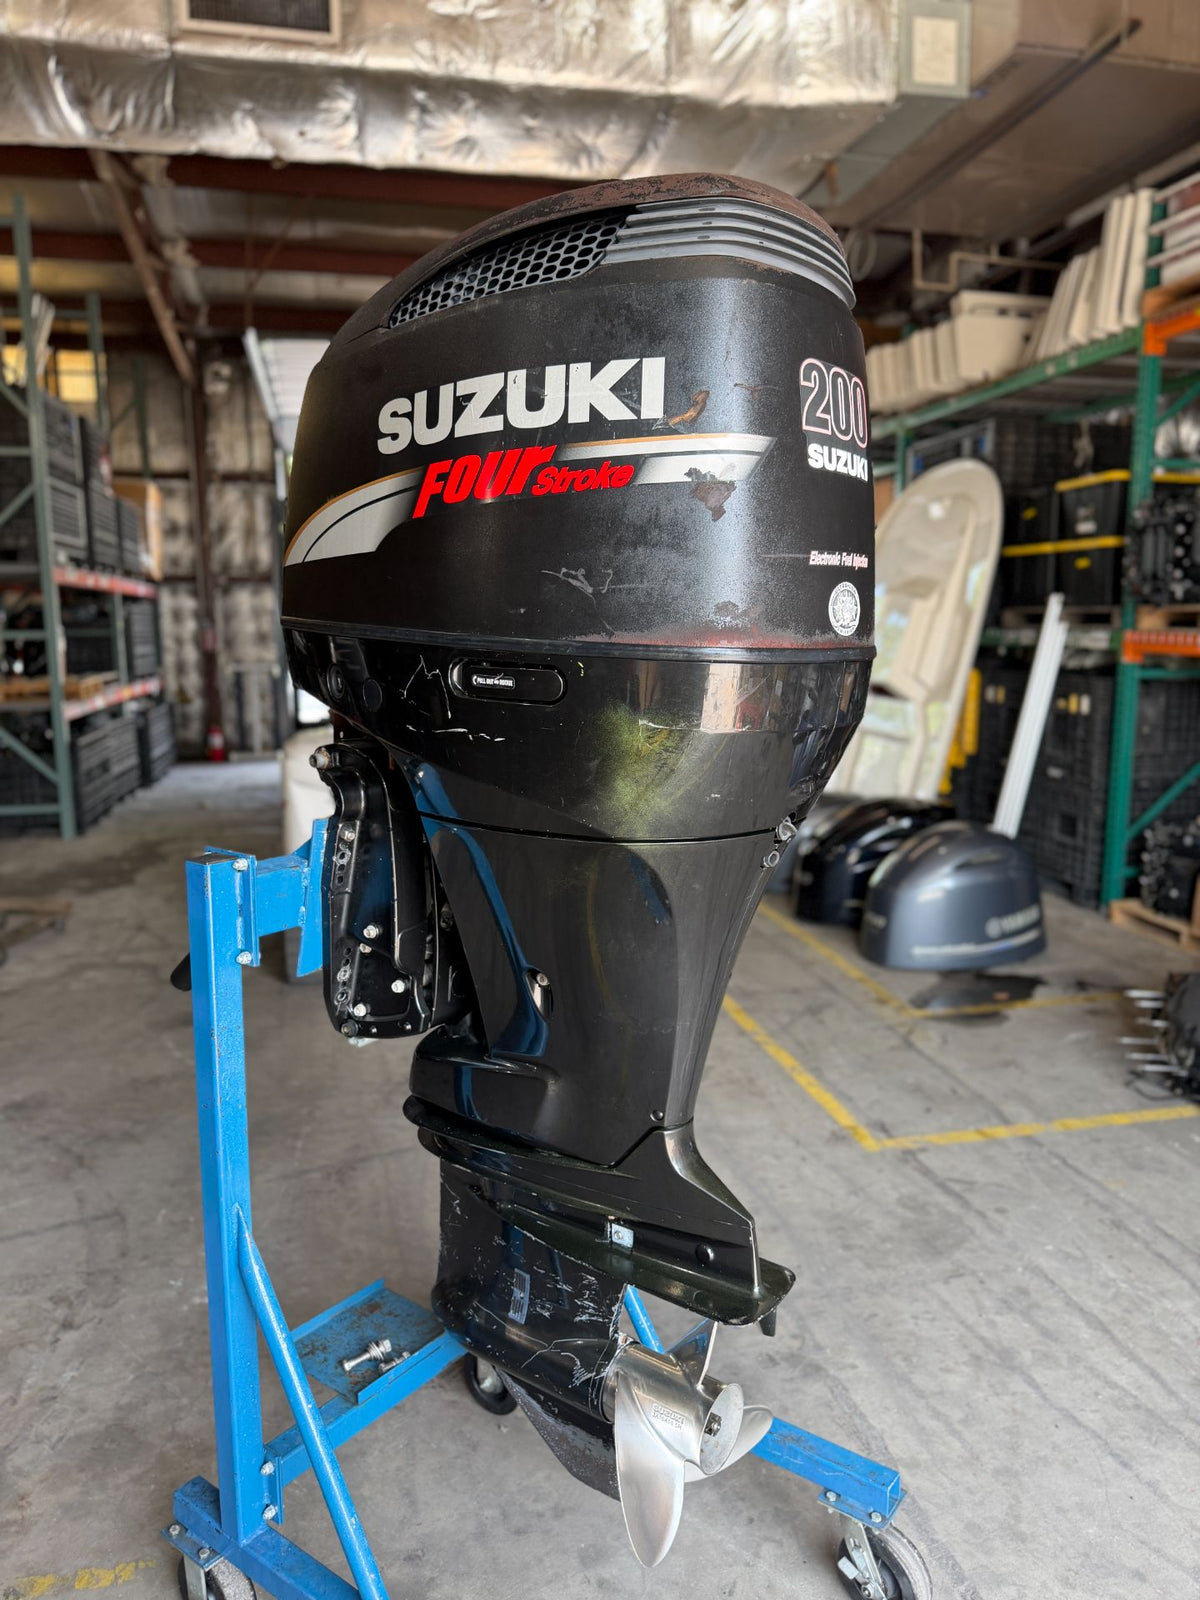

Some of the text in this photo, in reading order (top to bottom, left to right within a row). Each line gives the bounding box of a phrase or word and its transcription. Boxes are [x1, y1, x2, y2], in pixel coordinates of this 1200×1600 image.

[377, 357, 666, 455] SUZUKI
[800, 358, 868, 449] 200
[531, 461, 635, 496] Stroke
[808, 443, 868, 481] SUZUKI
[809, 550, 841, 566] Electronic
[841, 551, 853, 567] Fuel
